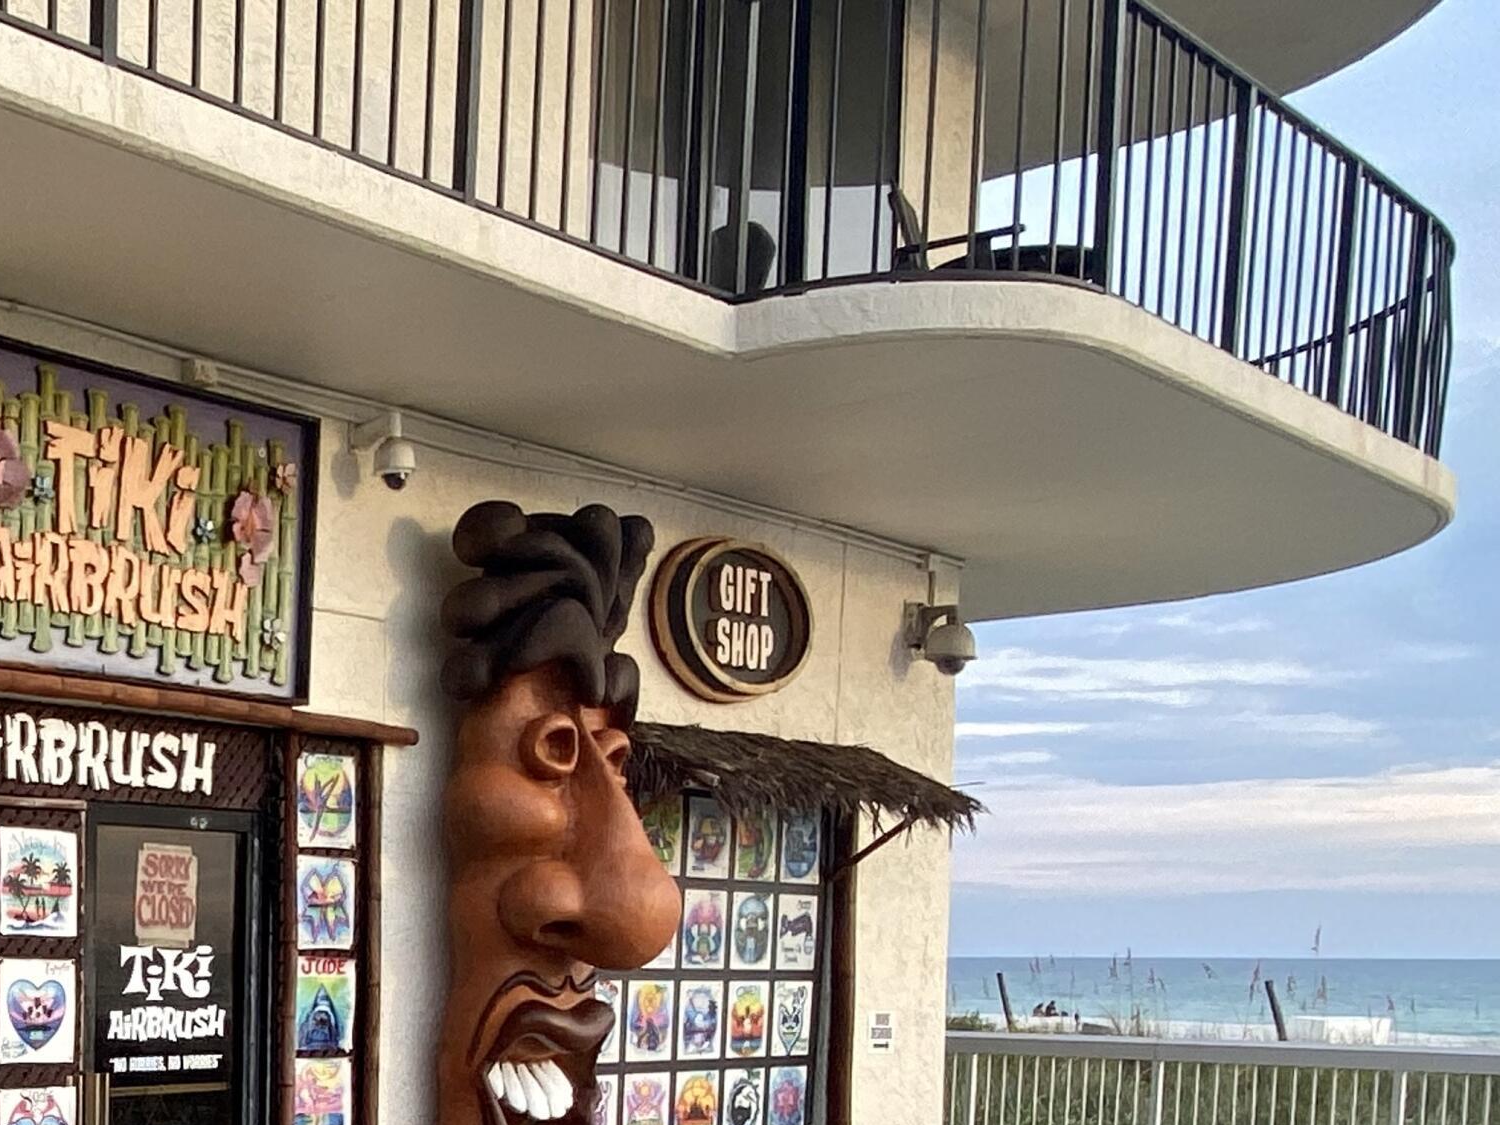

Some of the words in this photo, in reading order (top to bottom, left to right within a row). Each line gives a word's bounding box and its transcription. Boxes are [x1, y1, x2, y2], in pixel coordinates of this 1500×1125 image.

[719, 564, 773, 617] GIFT
[716, 616, 774, 671] SHOP
[143, 853, 192, 881] SORRY
[138, 896, 196, 930] CLOSED
[300, 958, 347, 976] JUDE
